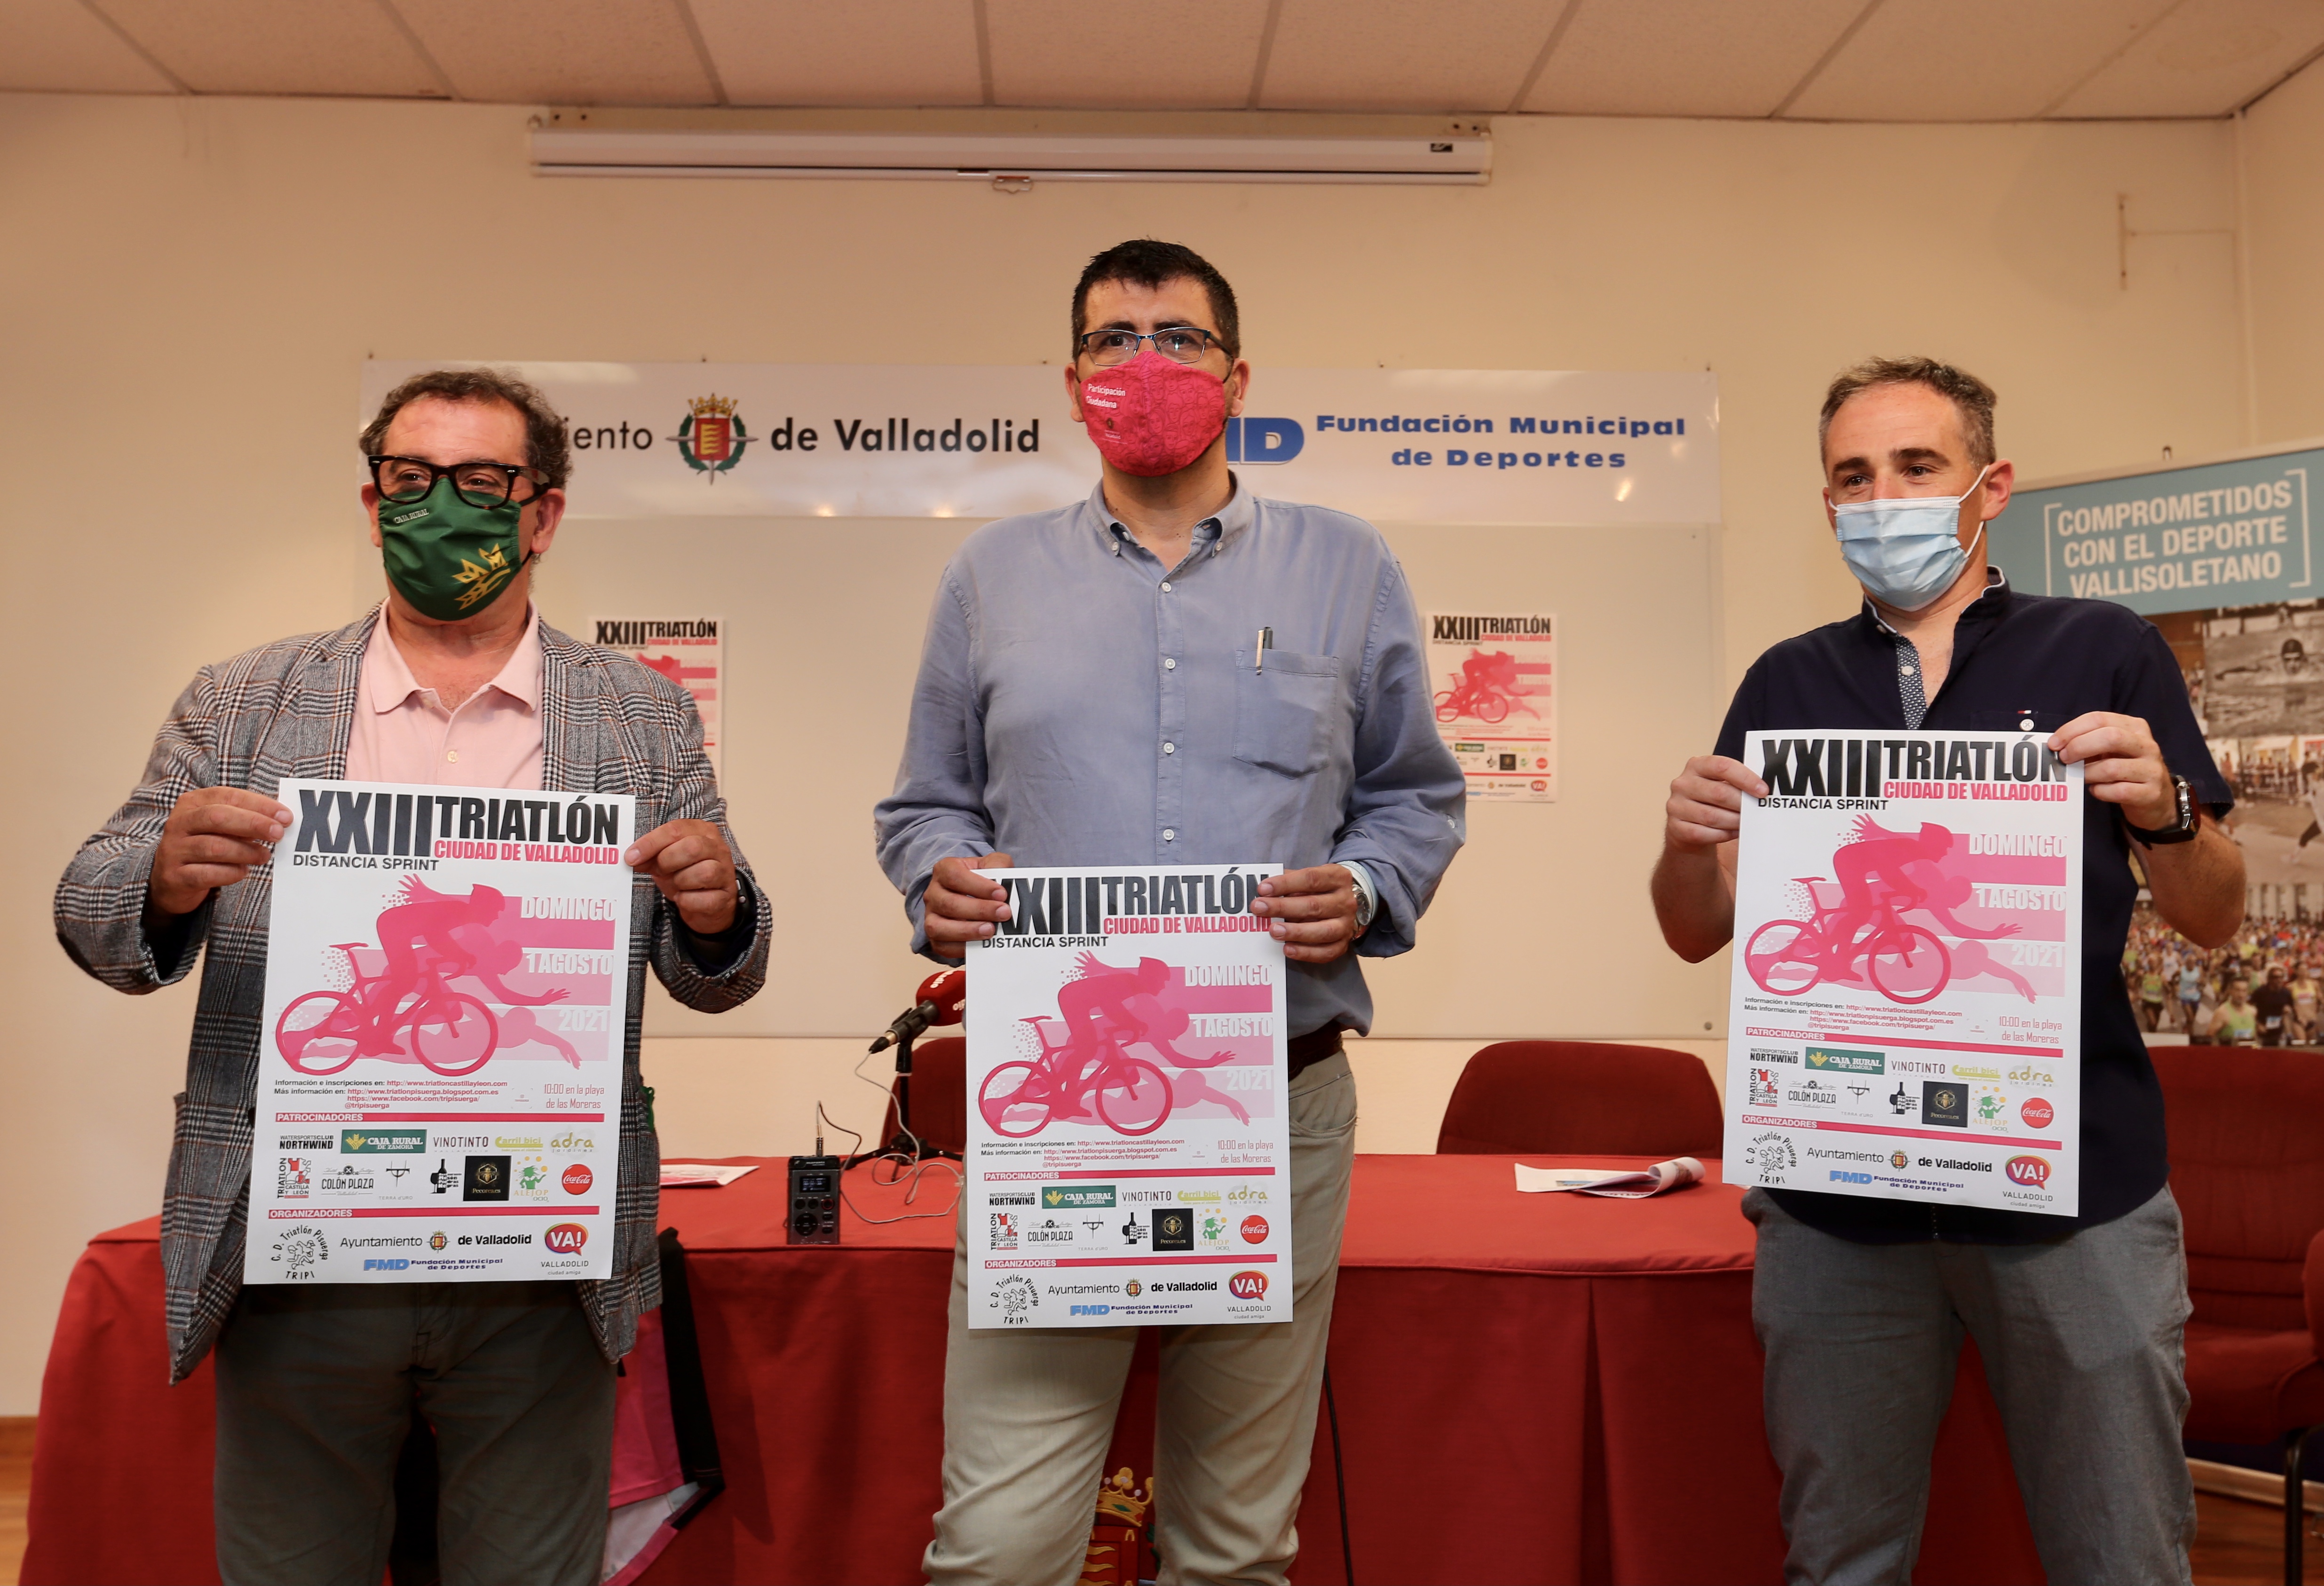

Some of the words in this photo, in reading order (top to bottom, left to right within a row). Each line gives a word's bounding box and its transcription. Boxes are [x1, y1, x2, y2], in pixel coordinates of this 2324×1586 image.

[1088, 383, 1126, 396] Participación
[1085, 395, 1117, 409] Ciudadana
[1317, 415, 1494, 433] Fundación
[1510, 417, 1685, 438] Municipal
[771, 418, 818, 451] de
[834, 418, 1039, 452] Valladolid
[1392, 449, 1432, 466] de
[1447, 450, 1626, 470] Deportes
[2057, 480, 2292, 537] COMPROMETIDOS
[394, 513, 410, 524] CAJA
[409, 509, 429, 520] RURAL
[2064, 537, 2116, 568] CON
[2124, 533, 2155, 562] EL
[2163, 515, 2288, 557] DEPORTE
[2070, 551, 2282, 598] VALLISOLETANO
[596, 621, 646, 644] XXIII
[647, 617, 717, 637] TRIATLÓN
[1433, 616, 1479, 640] XXIII
[1480, 615, 1551, 633] TRIATLÓN
[1761, 739, 1882, 797] XXIII
[1883, 782, 1944, 799] CIUDAD
[1947, 782, 1969, 799] DE
[1971, 783, 2067, 802] VALLADOLID
[1758, 797, 1833, 809] DISTANCIA
[1836, 799, 1889, 811] SPRINT
[294, 789, 435, 857] XXIII
[433, 795, 620, 845] TRIATLÓN
[434, 840, 498, 860] CIUDAD
[500, 843, 523, 861] DE
[525, 844, 619, 865] VALLADOLID
[1969, 833, 2067, 857] DOMINGO
[293, 854, 378, 869] DISTANCIA
[382, 857, 439, 871] SPRINT
[1989, 888, 2065, 911] AGOSTO
[521, 896, 617, 921] DOMINGO
[1103, 917, 1160, 934] CIUDAD
[1162, 917, 1183, 933] DE
[1185, 915, 1271, 933] VALLADOLID
[982, 937, 1055, 948] DISTANCIA
[1059, 936, 1108, 947] SPRINT
[2012, 943, 2063, 966] 2021
[538, 953, 613, 975] AGOSTO
[1185, 964, 1273, 986] DOMINGO
[559, 1008, 608, 1030] 2021
[1808, 1022, 1850, 1031] @tripisuerga
[1999, 1016, 2019, 1027] 10:00
[2022, 1019, 2031, 1028] en
[2033, 1018, 2039, 1028] la
[2041, 1018, 2062, 1032] playa
[1204, 1017, 1273, 1037] AGOSTO
[1747, 1027, 1825, 1041] PATROCINADORES
[2002, 1030, 2011, 1041] de
[2013, 1031, 2024, 1042] las
[2026, 1032, 2059, 1044] Moreras
[1750, 1052, 1798, 1064] NORTHWIND
[1829, 1055, 1850, 1065] CAJA
[1851, 1057, 1881, 1067] RURAL
[1891, 1060, 1945, 1074] VINOTINTO
[1227, 1068, 1272, 1089] 2021
[544, 1083, 564, 1094] 10:00
[577, 1084, 583, 1094] la
[585, 1084, 605, 1096] playa
[1788, 1089, 1811, 1102] COLÓN
[1812, 1092, 1836, 1104] PLAZA
[546, 1098, 555, 1108] de
[557, 1098, 568, 1108] las
[569, 1098, 601, 1109] Moreras
[1744, 1114, 1818, 1128] ORGANIZADORES
[279, 1140, 333, 1149] NORTHWIND
[433, 1136, 489, 1147] VINOTINTO
[551, 1132, 594, 1148] adra
[1218, 1140, 1236, 1150] 10:00
[1248, 1139, 1254, 1149] la
[1255, 1139, 1273, 1151] playa
[1221, 1153, 1229, 1163] de
[1231, 1153, 1241, 1163] las
[1242, 1153, 1271, 1163] Moreras
[1807, 1146, 1884, 1165] Ayuntamiento
[1918, 1156, 1932, 1167] de
[1935, 1158, 1992, 1173] Valladolid
[277, 1158, 287, 1198] TRIATLON
[1829, 1170, 1873, 1185] FMD
[2011, 1162, 2044, 1181] VA!
[322, 1177, 347, 1189] COLÓN
[348, 1178, 374, 1189] PLAZA
[1873, 1175, 1917, 1184] Fundación
[1920, 1179, 1964, 1189] Municipal
[989, 1197, 1035, 1206] NORTHWIND
[1122, 1191, 1171, 1201] VINOTINTO
[2003, 1191, 2053, 1202] VALLADOLID
[270, 1209, 353, 1218] ORGANIZADORES
[340, 1236, 423, 1249] Ayuntamiento
[458, 1235, 472, 1245] de
[475, 1234, 532, 1245] Valladolid
[550, 1231, 582, 1247] VA!
[1028, 1230, 1049, 1241] COLÓN
[1051, 1231, 1073, 1241] PLAZA
[364, 1259, 410, 1271] FMD
[986, 1259, 1057, 1268] ORGANIZADORES
[1048, 1284, 1120, 1295] Ayuntamiento
[1151, 1282, 1164, 1292] de
[1166, 1281, 1217, 1291] Valladolid
[1234, 1278, 1263, 1294] VA!
[1070, 1304, 1110, 1316] FMD
